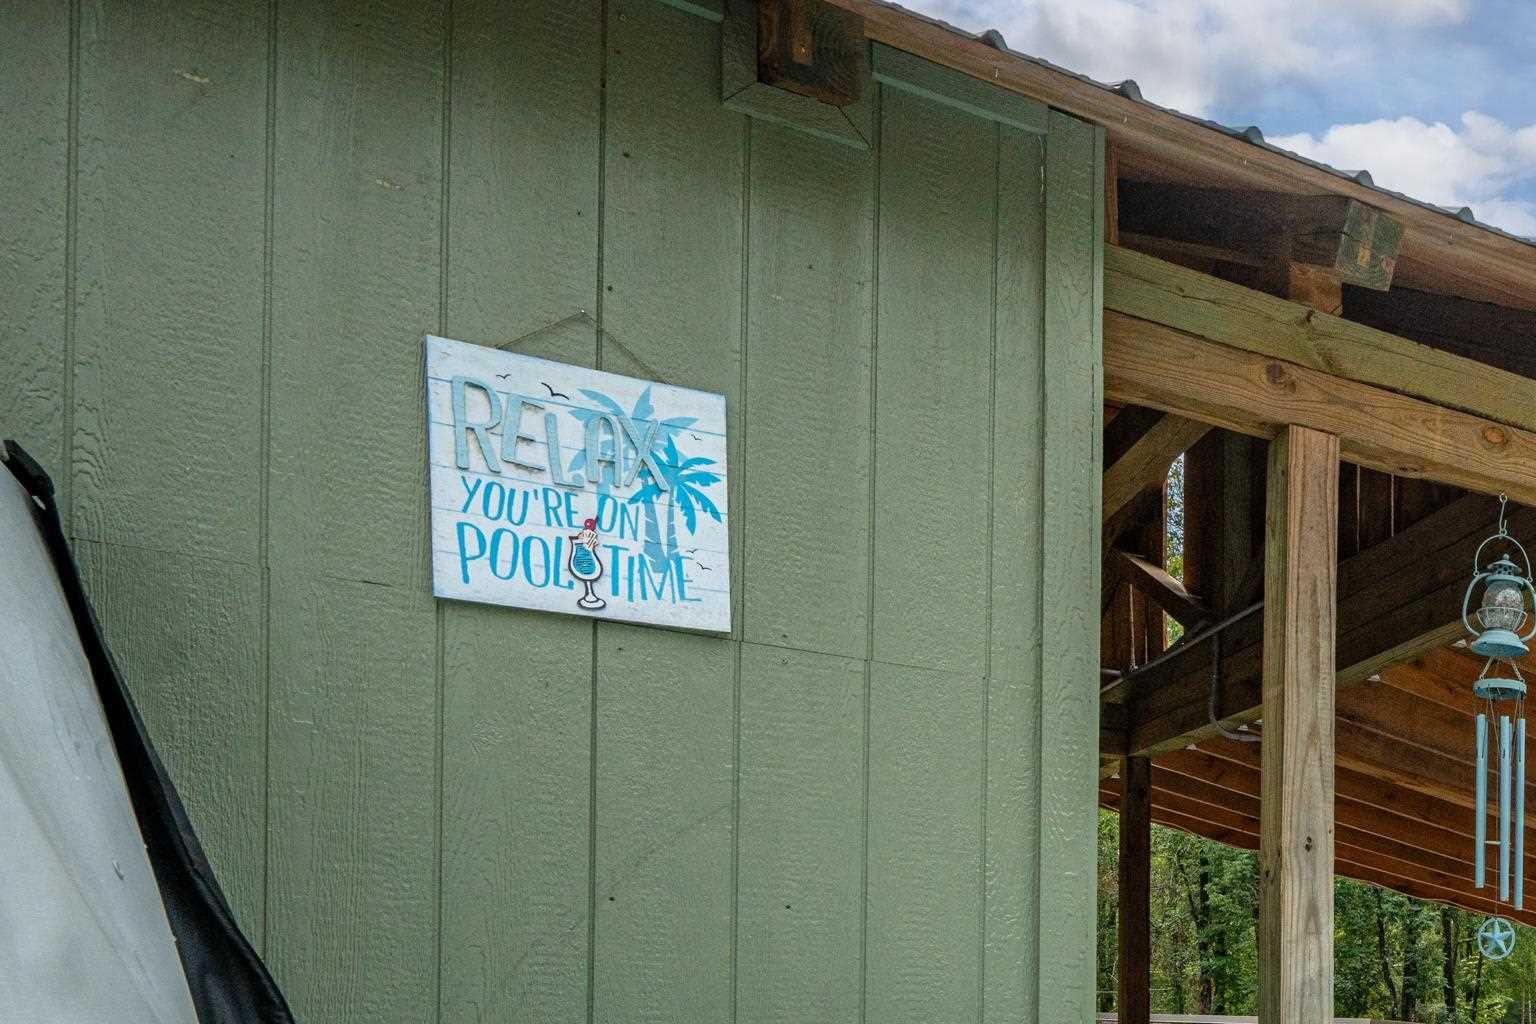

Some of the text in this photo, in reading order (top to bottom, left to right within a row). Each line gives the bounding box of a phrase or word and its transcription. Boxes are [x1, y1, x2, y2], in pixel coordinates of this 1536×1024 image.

[451, 376, 669, 492] RELAX
[461, 476, 640, 540] YOU'RE ON
[457, 521, 702, 604] POOL TIME
